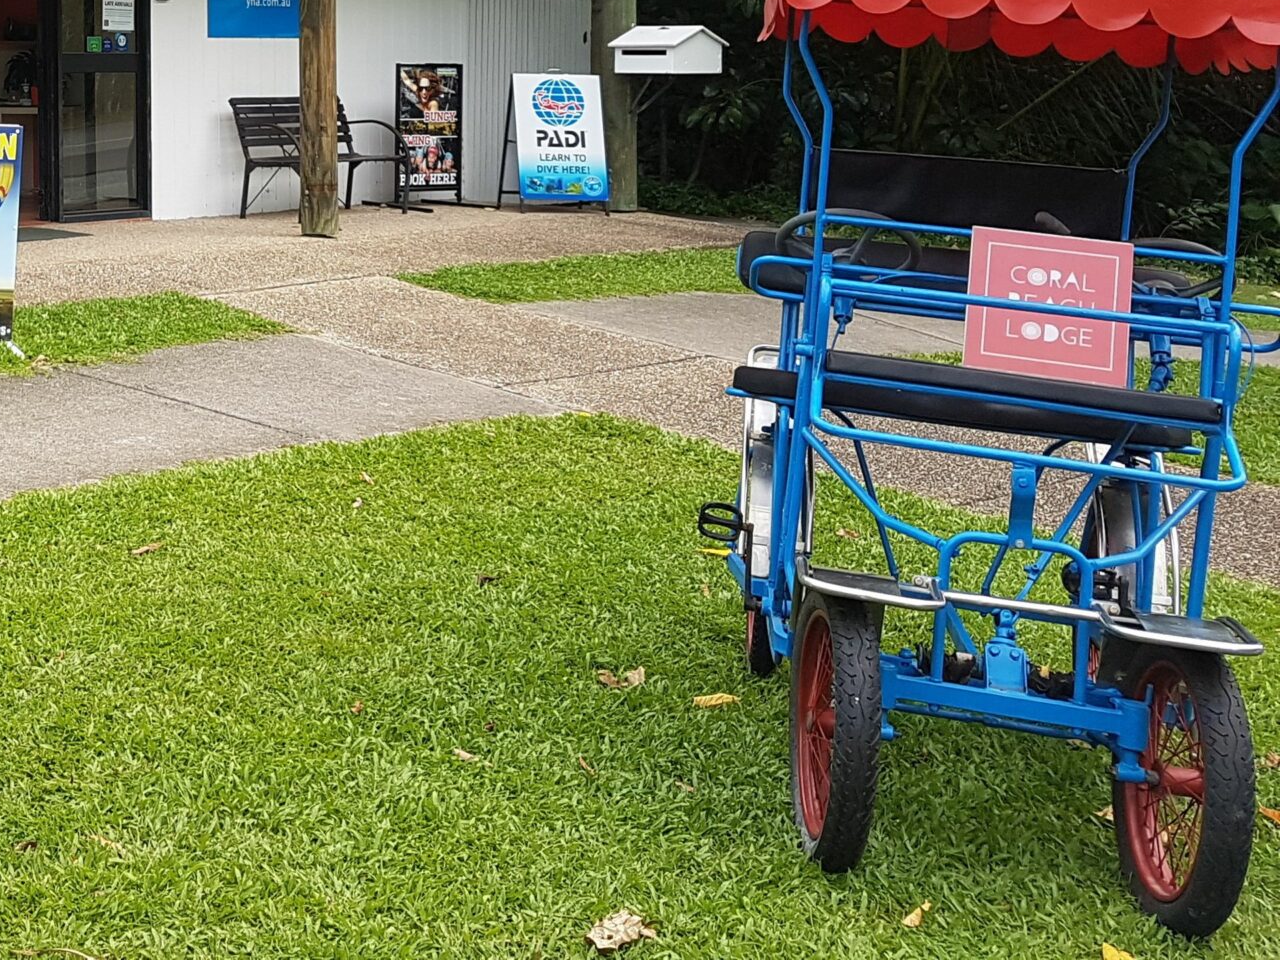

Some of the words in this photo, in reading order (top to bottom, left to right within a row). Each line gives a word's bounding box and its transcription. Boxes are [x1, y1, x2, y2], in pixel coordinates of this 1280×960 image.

[425, 111, 456, 122] BUNGY
[536, 130, 586, 148] PADI
[574, 154, 586, 162] TO
[562, 166, 590, 174] HERE!
[429, 173, 456, 185] HERE
[1010, 265, 1095, 293] CORAL
[1006, 319, 1093, 348] LODGE
